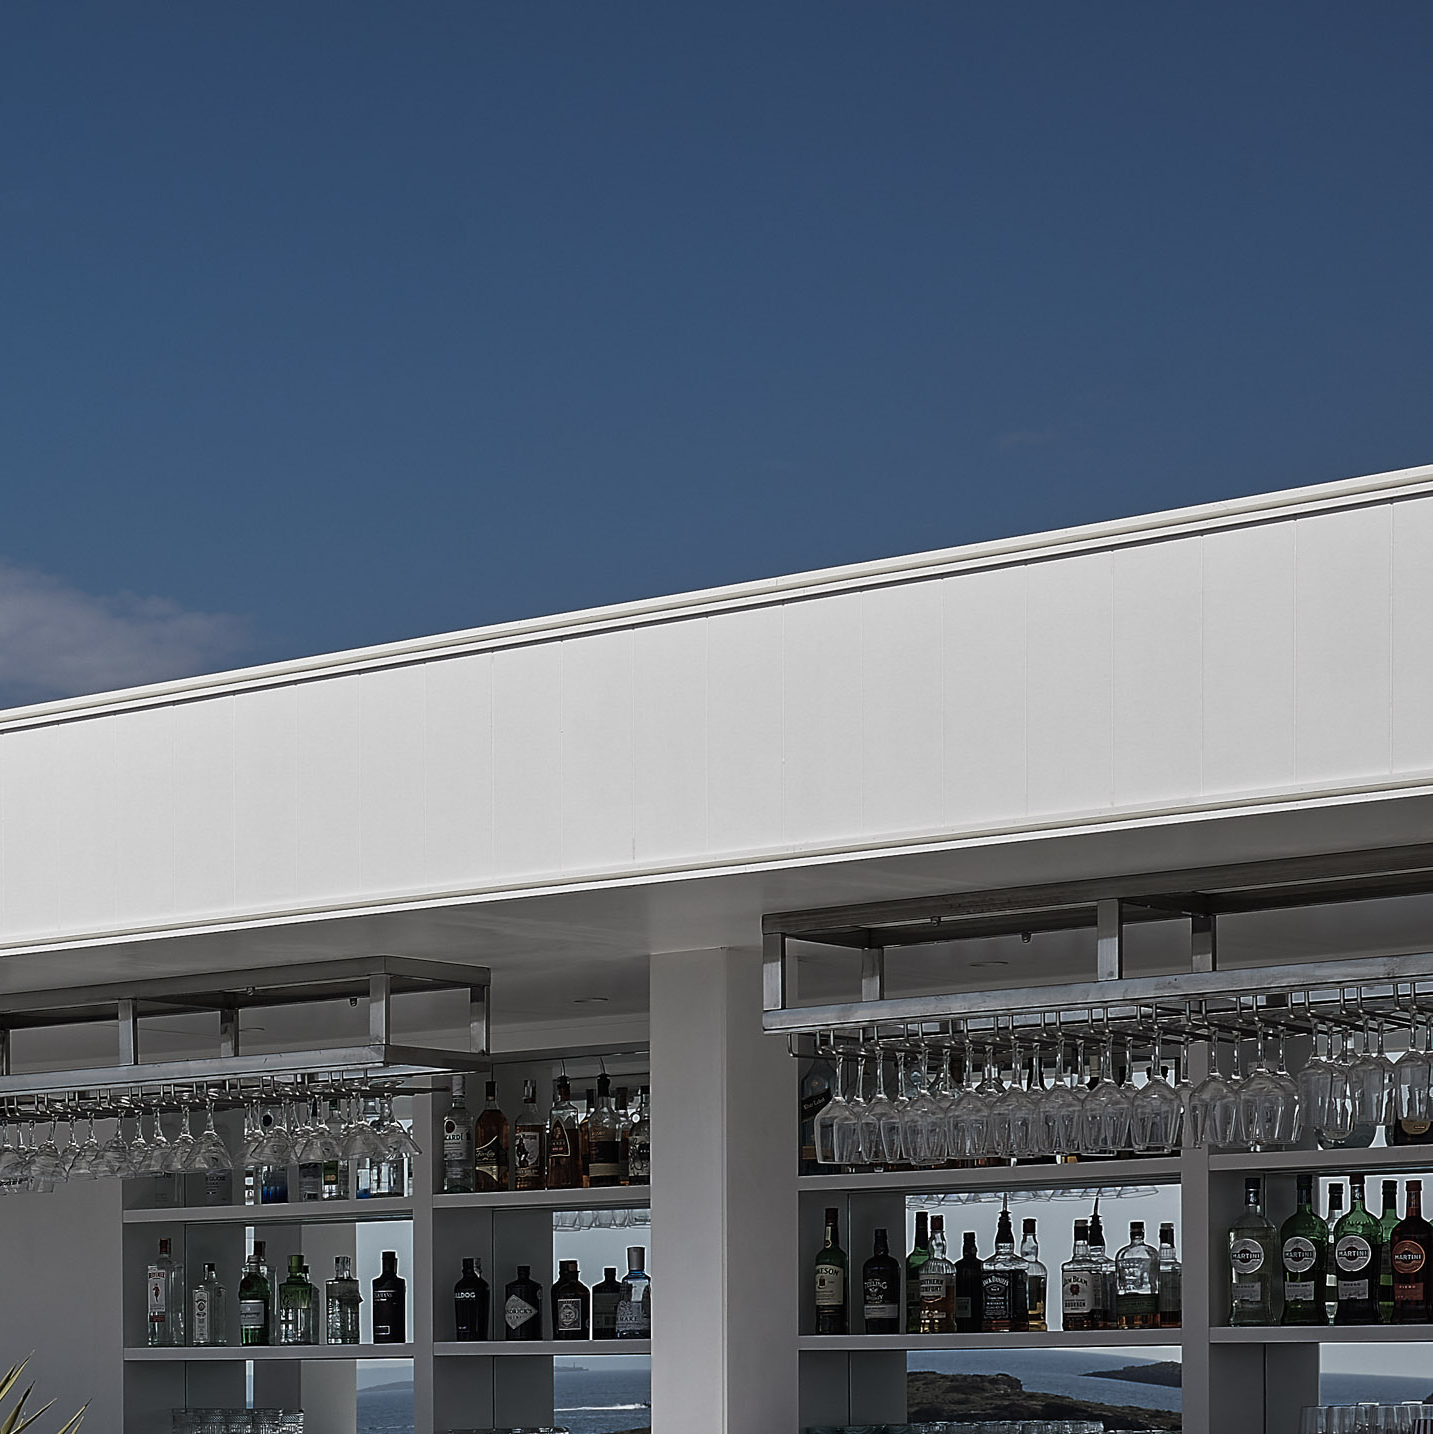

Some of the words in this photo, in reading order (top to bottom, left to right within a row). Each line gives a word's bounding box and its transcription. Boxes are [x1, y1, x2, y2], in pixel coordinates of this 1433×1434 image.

[1232, 1252, 1261, 1260] MARTINI
[1285, 1250, 1314, 1259] MARTINI
[1338, 1249, 1368, 1258] MARTINI
[1394, 1253, 1422, 1261] MARTINI
[1072, 1275, 1088, 1286] BEAM
[453, 1291, 476, 1299] LLDOG
